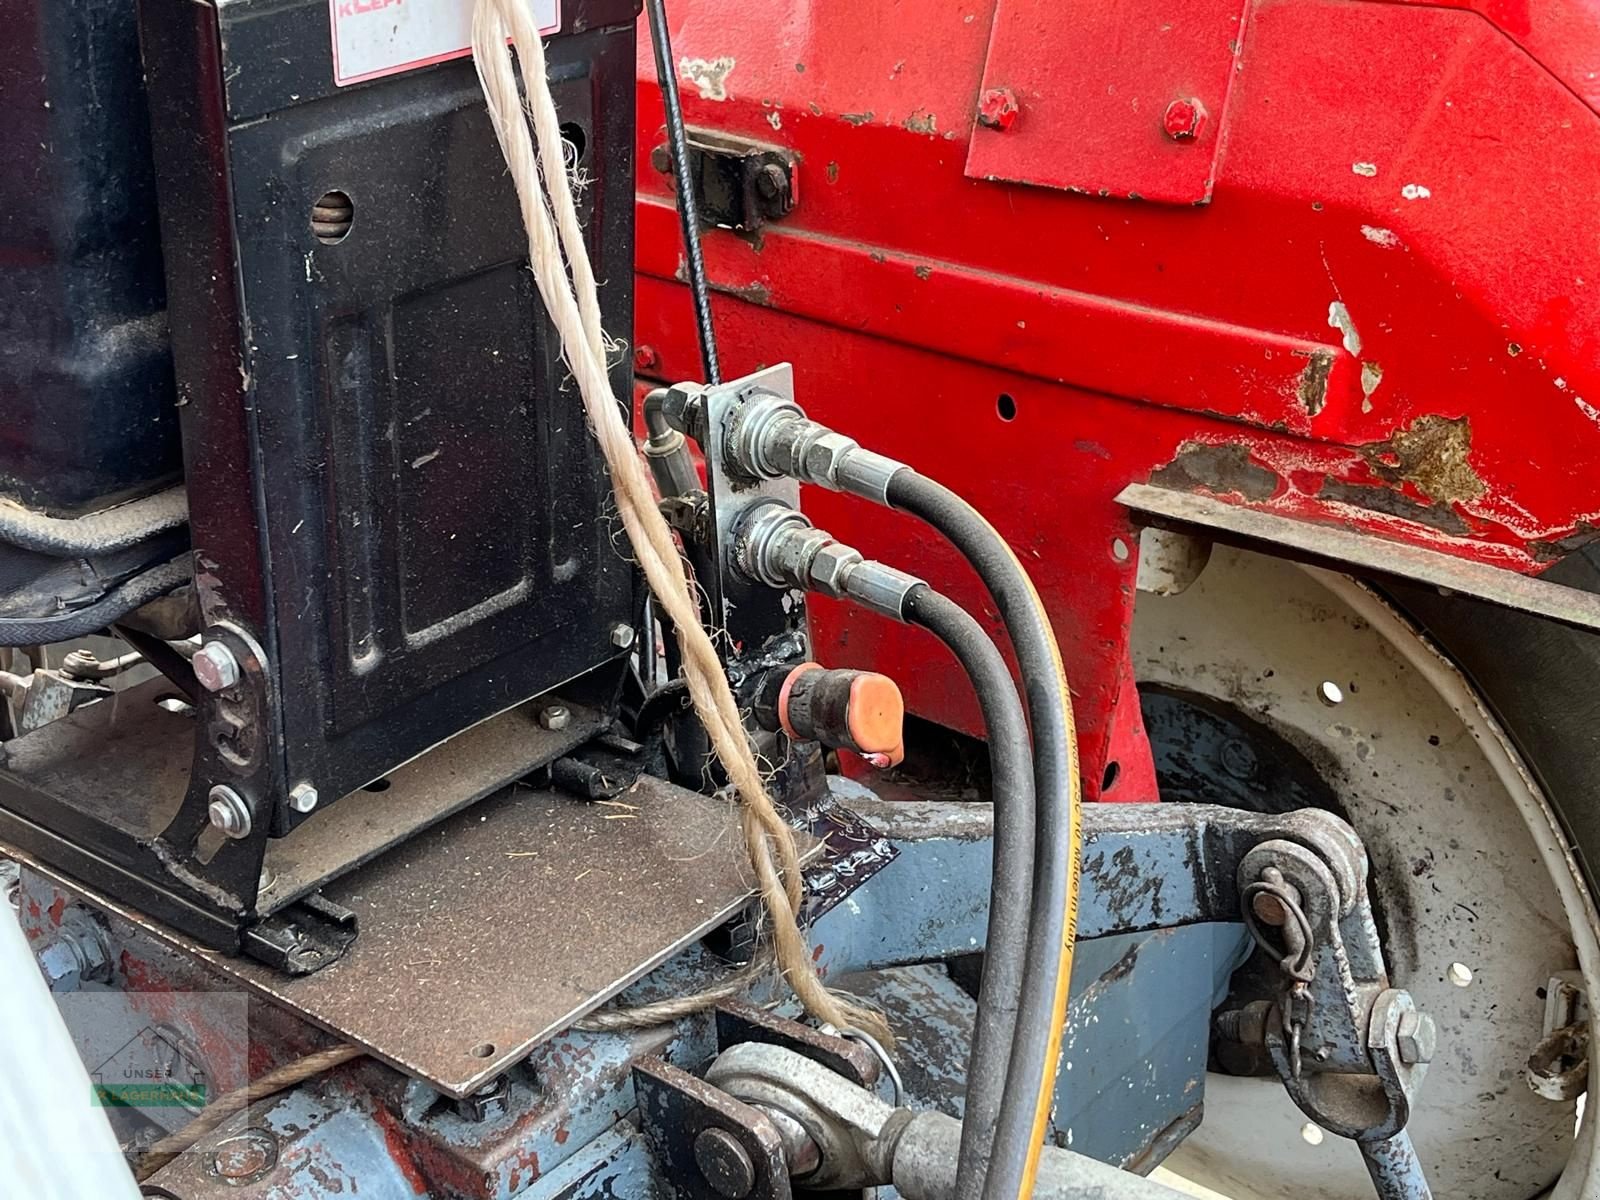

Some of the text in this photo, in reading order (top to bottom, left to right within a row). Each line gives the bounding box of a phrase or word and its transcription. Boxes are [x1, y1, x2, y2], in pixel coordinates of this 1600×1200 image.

[1072, 847, 1082, 893] Made
[1070, 896, 1079, 913] in
[1065, 917, 1078, 953] Italy
